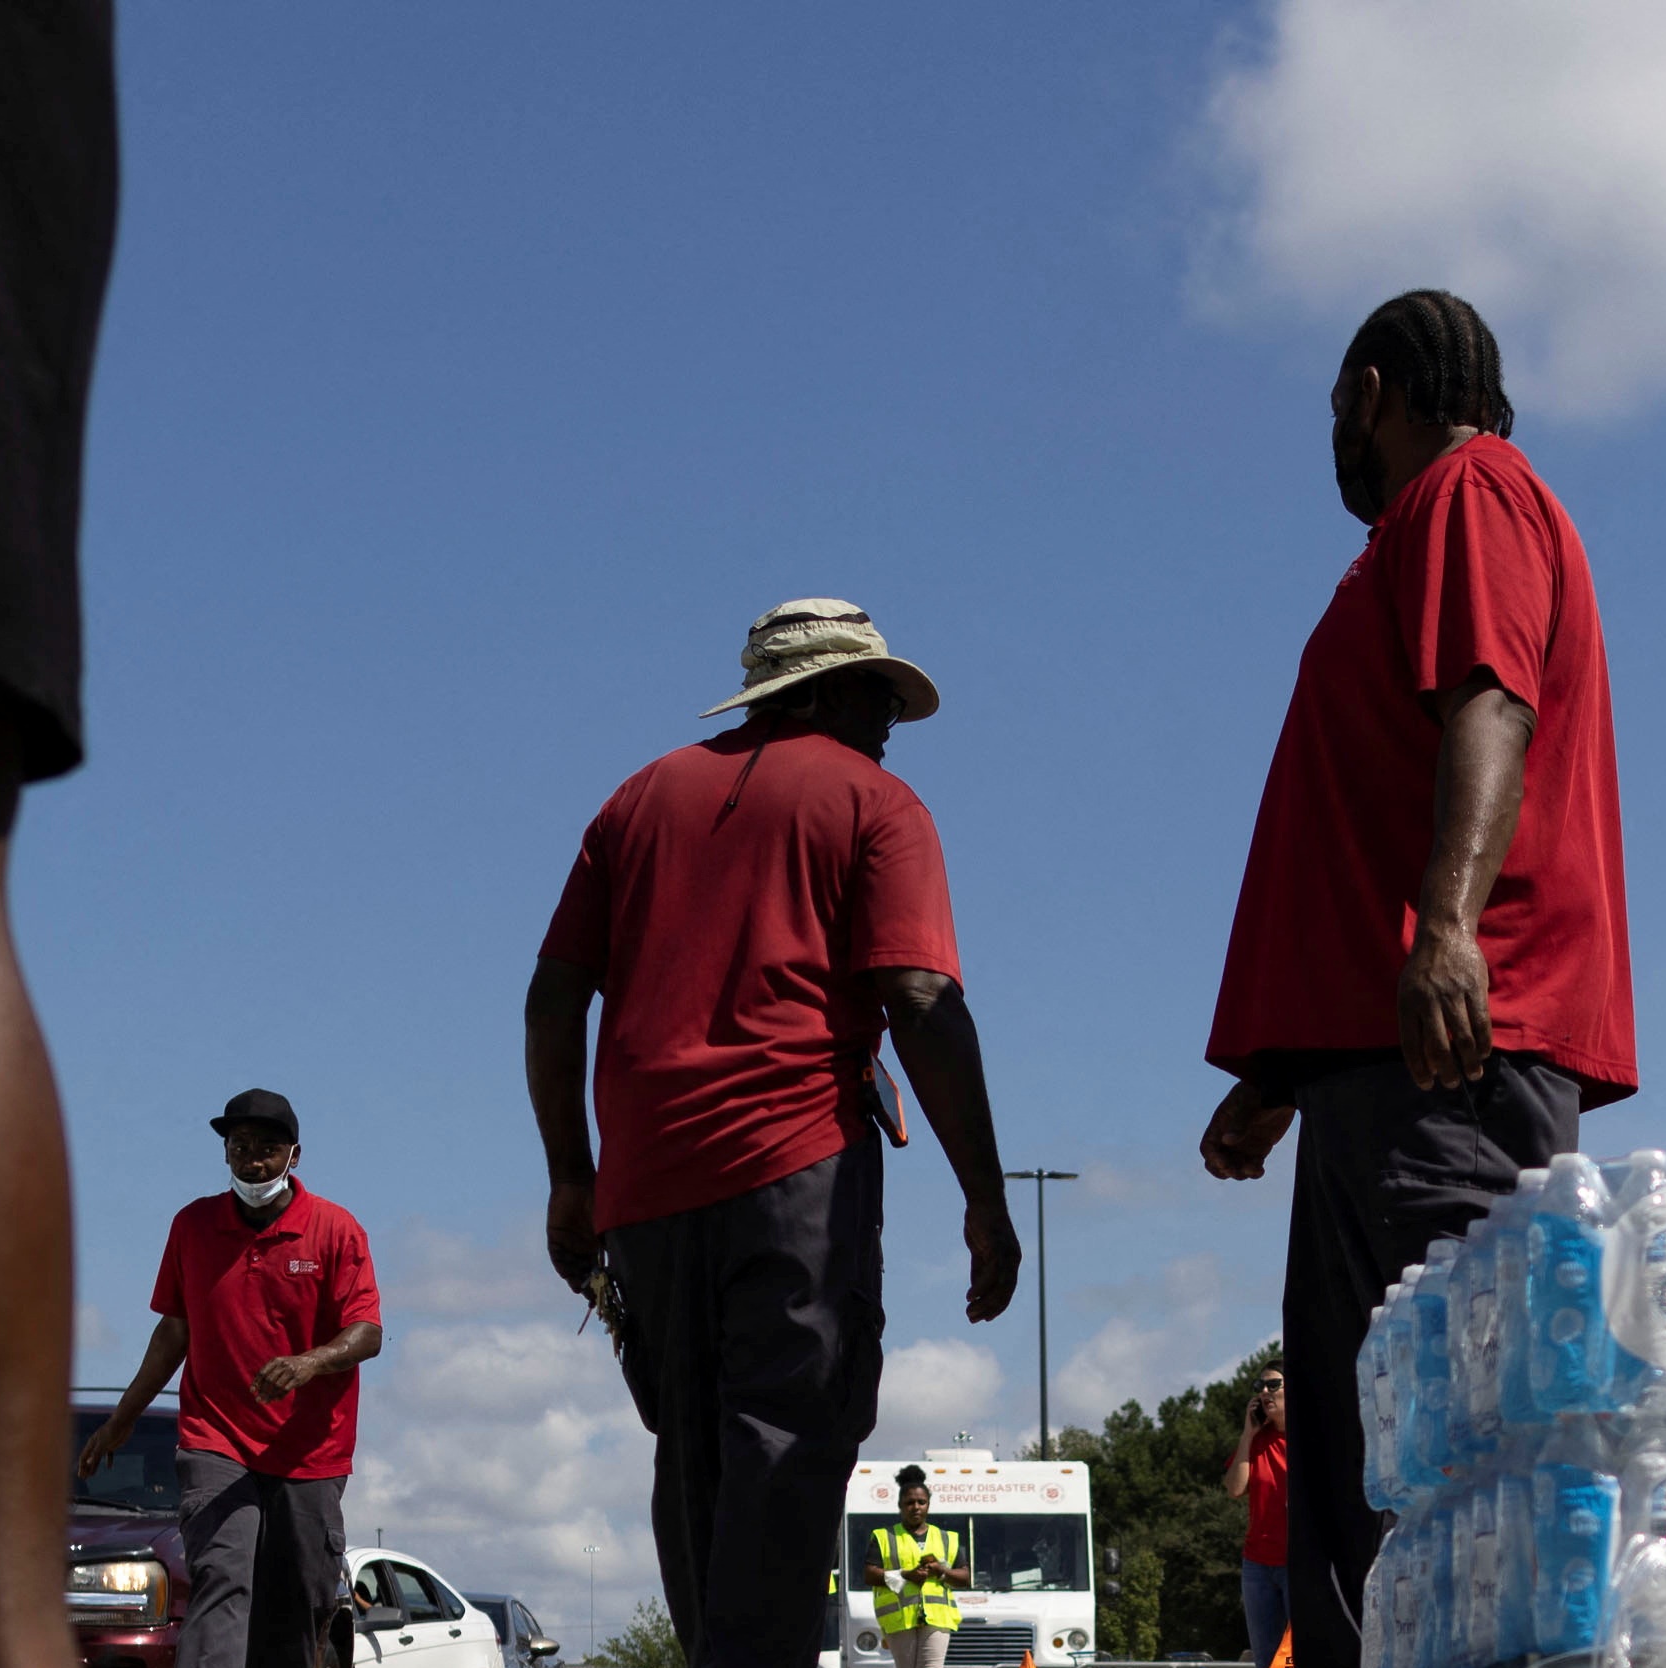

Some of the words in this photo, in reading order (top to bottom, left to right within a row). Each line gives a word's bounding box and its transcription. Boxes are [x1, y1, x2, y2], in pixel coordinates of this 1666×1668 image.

[927, 1483, 974, 1493] RGENCY
[977, 1483, 1036, 1493] DISASTER
[939, 1494, 998, 1503] SERVICES
